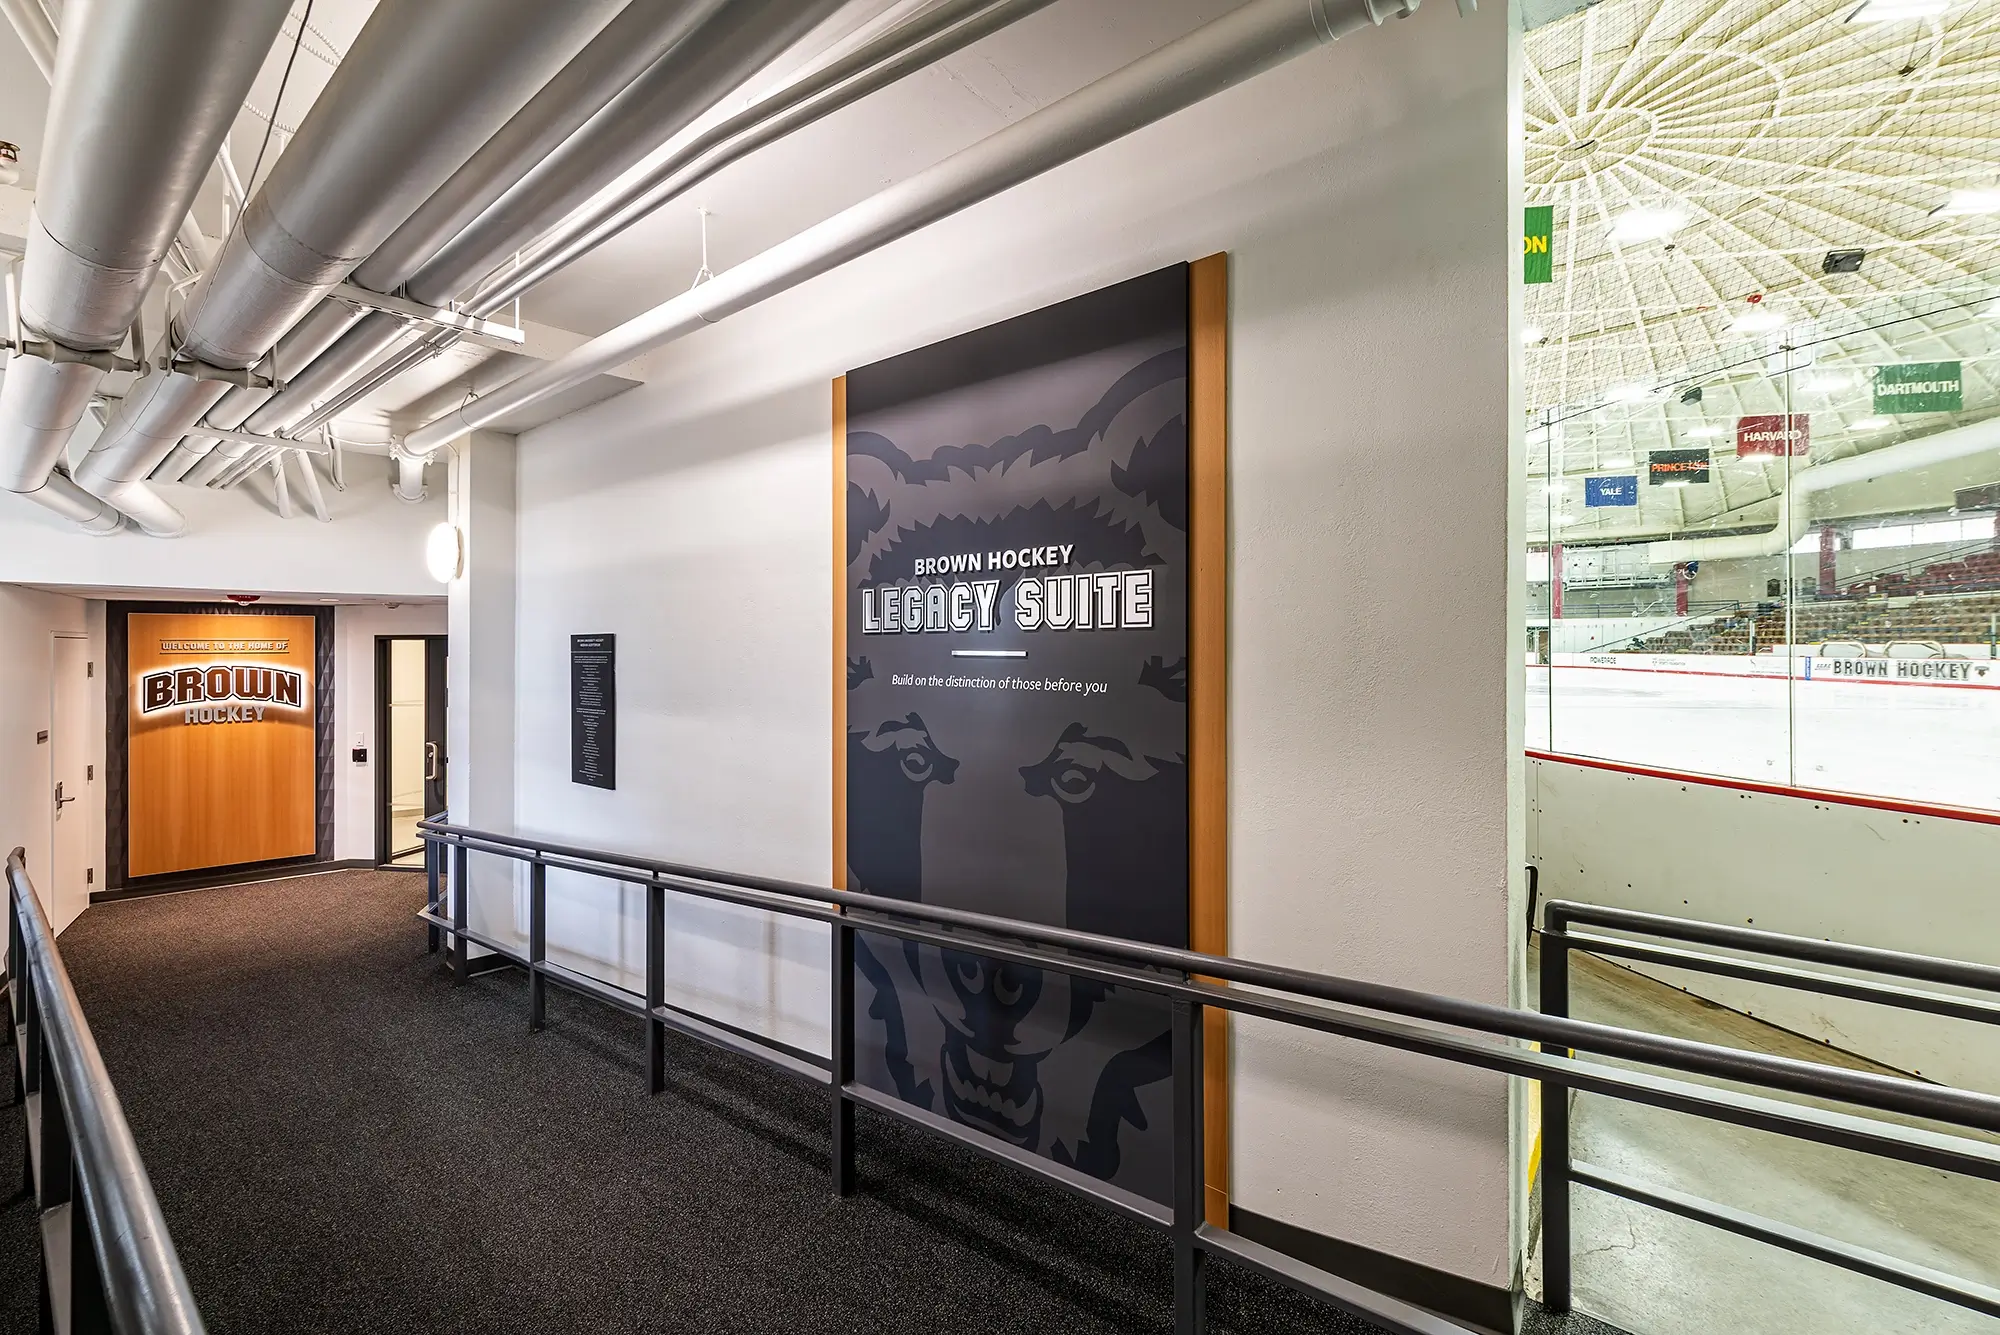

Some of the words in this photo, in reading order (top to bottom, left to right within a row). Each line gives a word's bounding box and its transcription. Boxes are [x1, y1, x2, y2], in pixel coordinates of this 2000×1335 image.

[1877, 380, 1960, 396] DARTMOUTH
[1744, 429, 1802, 442] HARVARD
[1600, 487, 1622, 496] YALE
[914, 552, 982, 576] BROWN
[988, 544, 1075, 571] HOCKEY
[862, 579, 1001, 634] LEGACY
[1014, 569, 1154, 632] SUITE
[161, 642, 210, 651] WELCOME
[213, 642, 225, 650] TO
[229, 642, 246, 651] THE
[248, 642, 274, 651] HOME
[276, 642, 289, 650] OF
[1833, 659, 1889, 677] BROWN
[1897, 660, 1974, 681] HOCKEY
[143, 666, 302, 713] BROWN
[892, 674, 914, 686] Build
[915, 677, 927, 686] on
[928, 675, 944, 687] the
[945, 675, 996, 689] distinction
[998, 676, 1011, 689] of
[1012, 677, 1042, 691] those
[1044, 678, 1083, 692] before
[1083, 682, 1108, 697] you
[184, 705, 266, 726] HOCKEY
